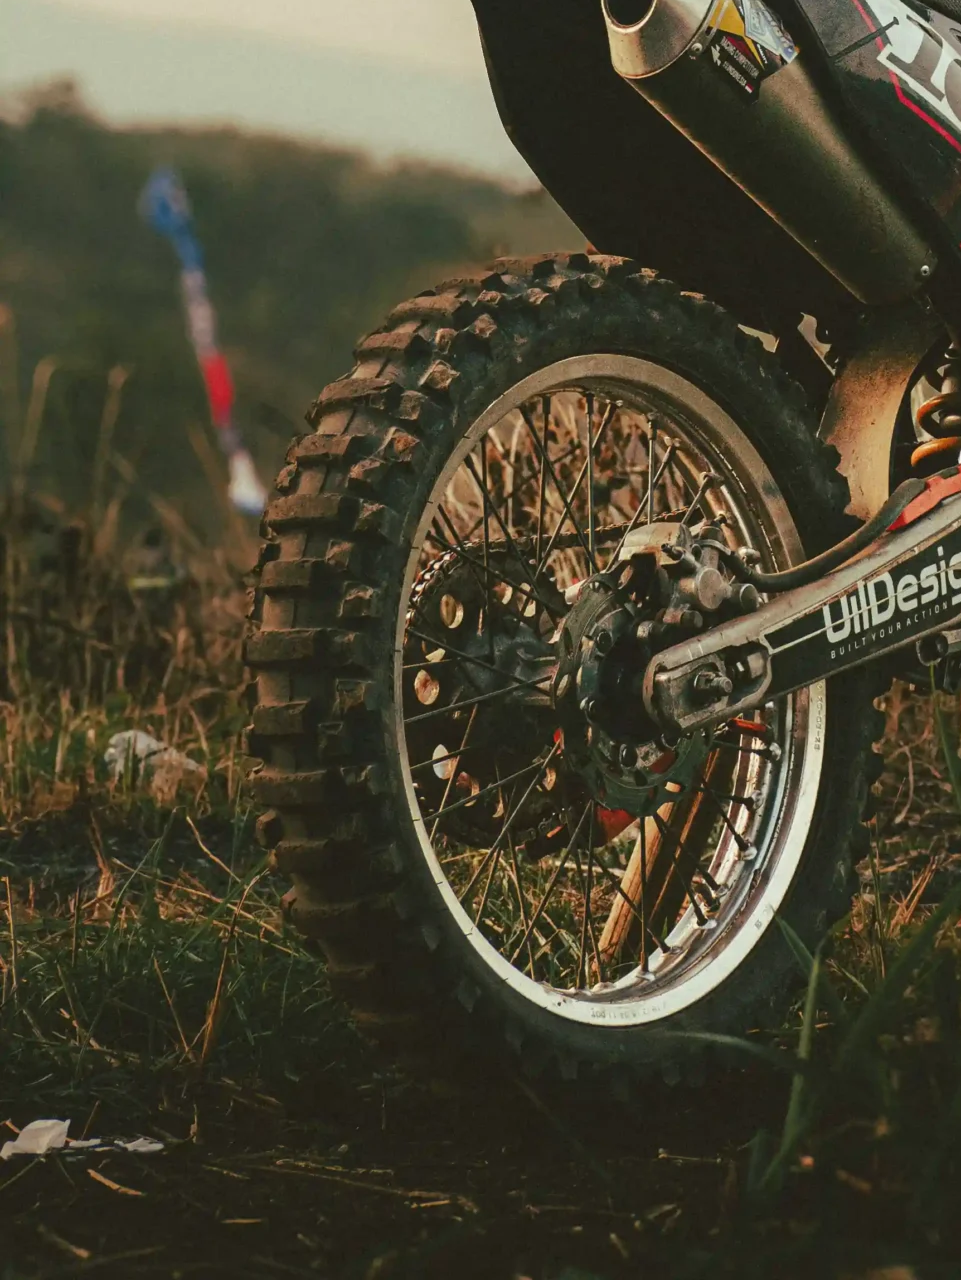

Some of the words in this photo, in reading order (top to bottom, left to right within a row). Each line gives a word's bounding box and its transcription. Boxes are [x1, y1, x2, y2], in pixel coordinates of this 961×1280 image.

[830, 637, 866, 660] BUILT
[871, 622, 902, 641] YOUR
[906, 601, 948, 626] ACTION
